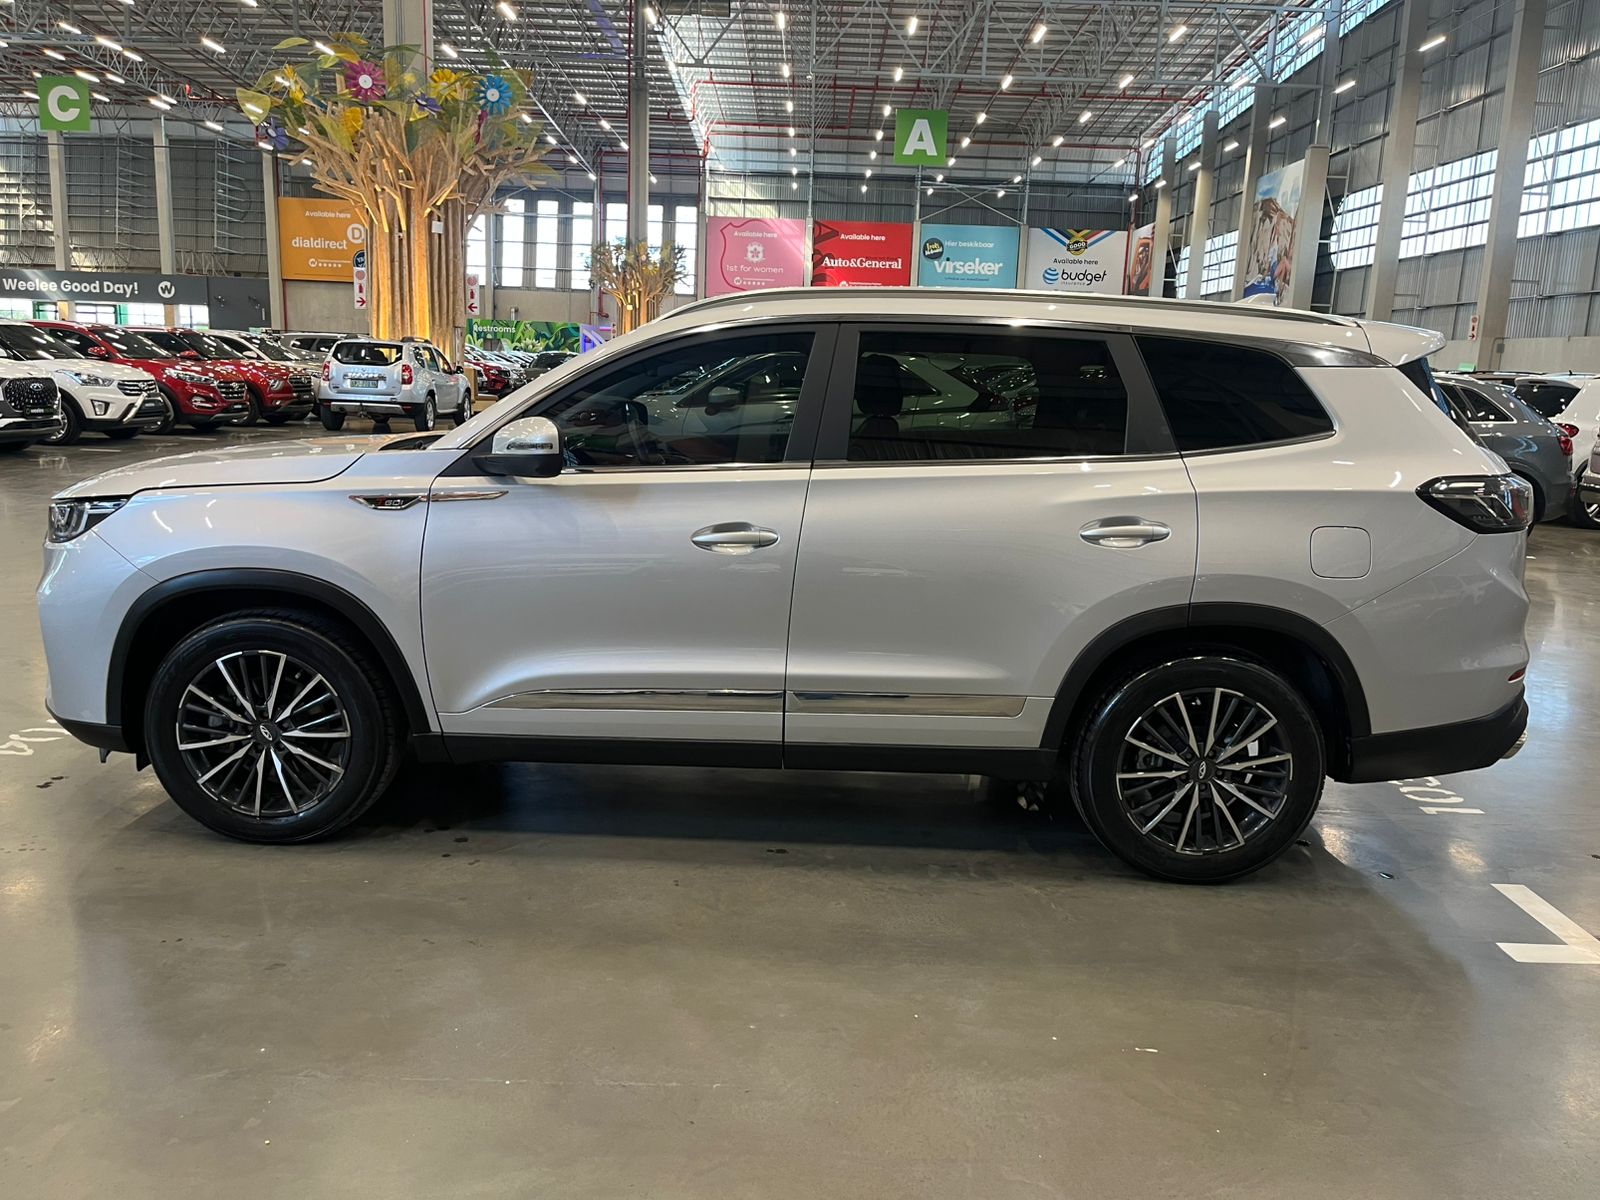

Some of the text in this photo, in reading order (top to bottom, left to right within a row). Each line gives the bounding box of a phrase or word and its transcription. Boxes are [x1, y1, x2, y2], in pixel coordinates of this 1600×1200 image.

[47, 85, 80, 122] C
[902, 118, 938, 156] A
[305, 210, 351, 219] Available here
[292, 236, 348, 250] dialdirect
[840, 233, 886, 242] Available here
[821, 256, 902, 269] Auto&General
[934, 257, 1003, 275] virseker
[1053, 257, 1083, 265] Available
[726, 264, 739, 272] 1st
[740, 264, 752, 272] for
[1061, 268, 1107, 286] budget
[2, 278, 139, 298] Weelee Good Day!
[473, 324, 516, 334] Restrooms
